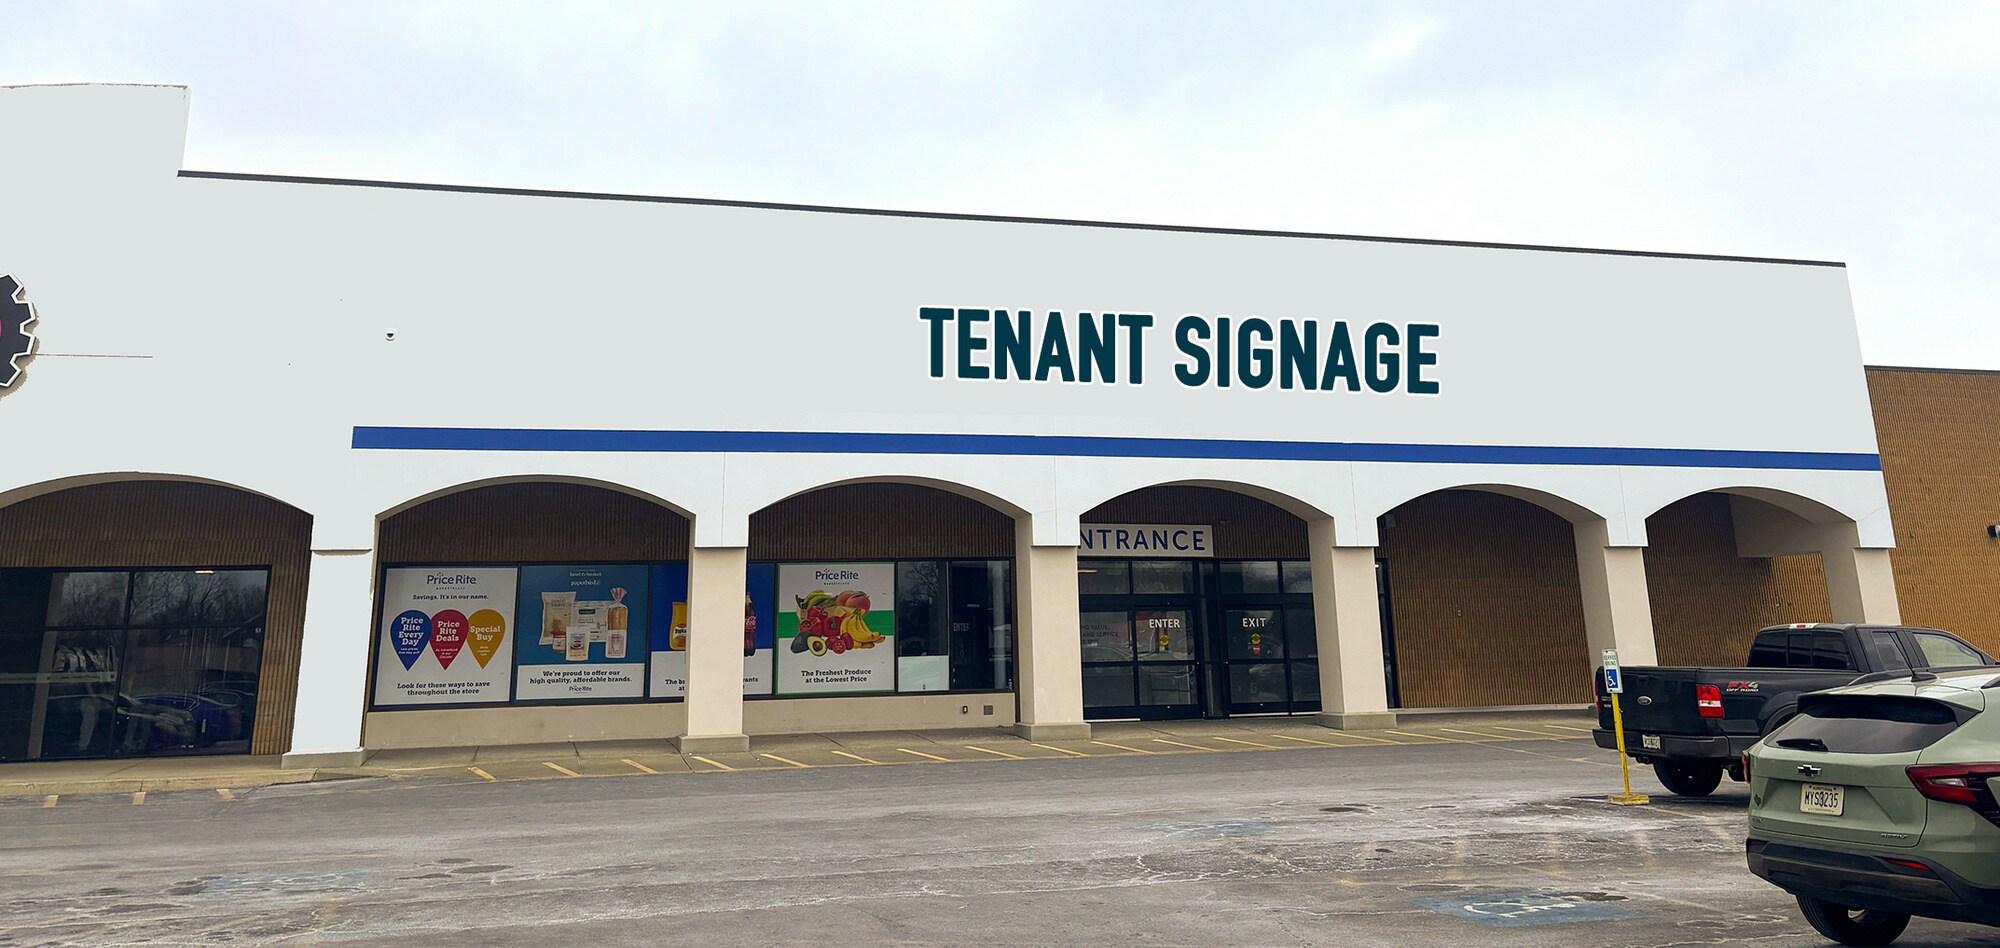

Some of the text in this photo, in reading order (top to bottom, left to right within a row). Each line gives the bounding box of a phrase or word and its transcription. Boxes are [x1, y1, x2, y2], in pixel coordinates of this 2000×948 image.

[919, 306, 1440, 395] TENANT SIGNAGE
[1079, 529, 1206, 551] NTRANCE
[815, 570, 859, 580] Price Rite
[427, 574, 477, 585] Price Rite
[437, 620, 460, 628] Price
[1149, 618, 1180, 629] ENTER
[1242, 617, 1267, 628] EXIT
[439, 627, 457, 635] Rite
[469, 625, 501, 634] Special
[398, 631, 424, 639] Every
[435, 634, 460, 642] Deals
[476, 633, 493, 642] Buy
[402, 638, 420, 646] Day
[844, 668, 872, 676] Produce
[546, 677, 572, 685] quality,
[1727, 681, 1759, 689] FX4
[407, 689, 448, 697] throughout
